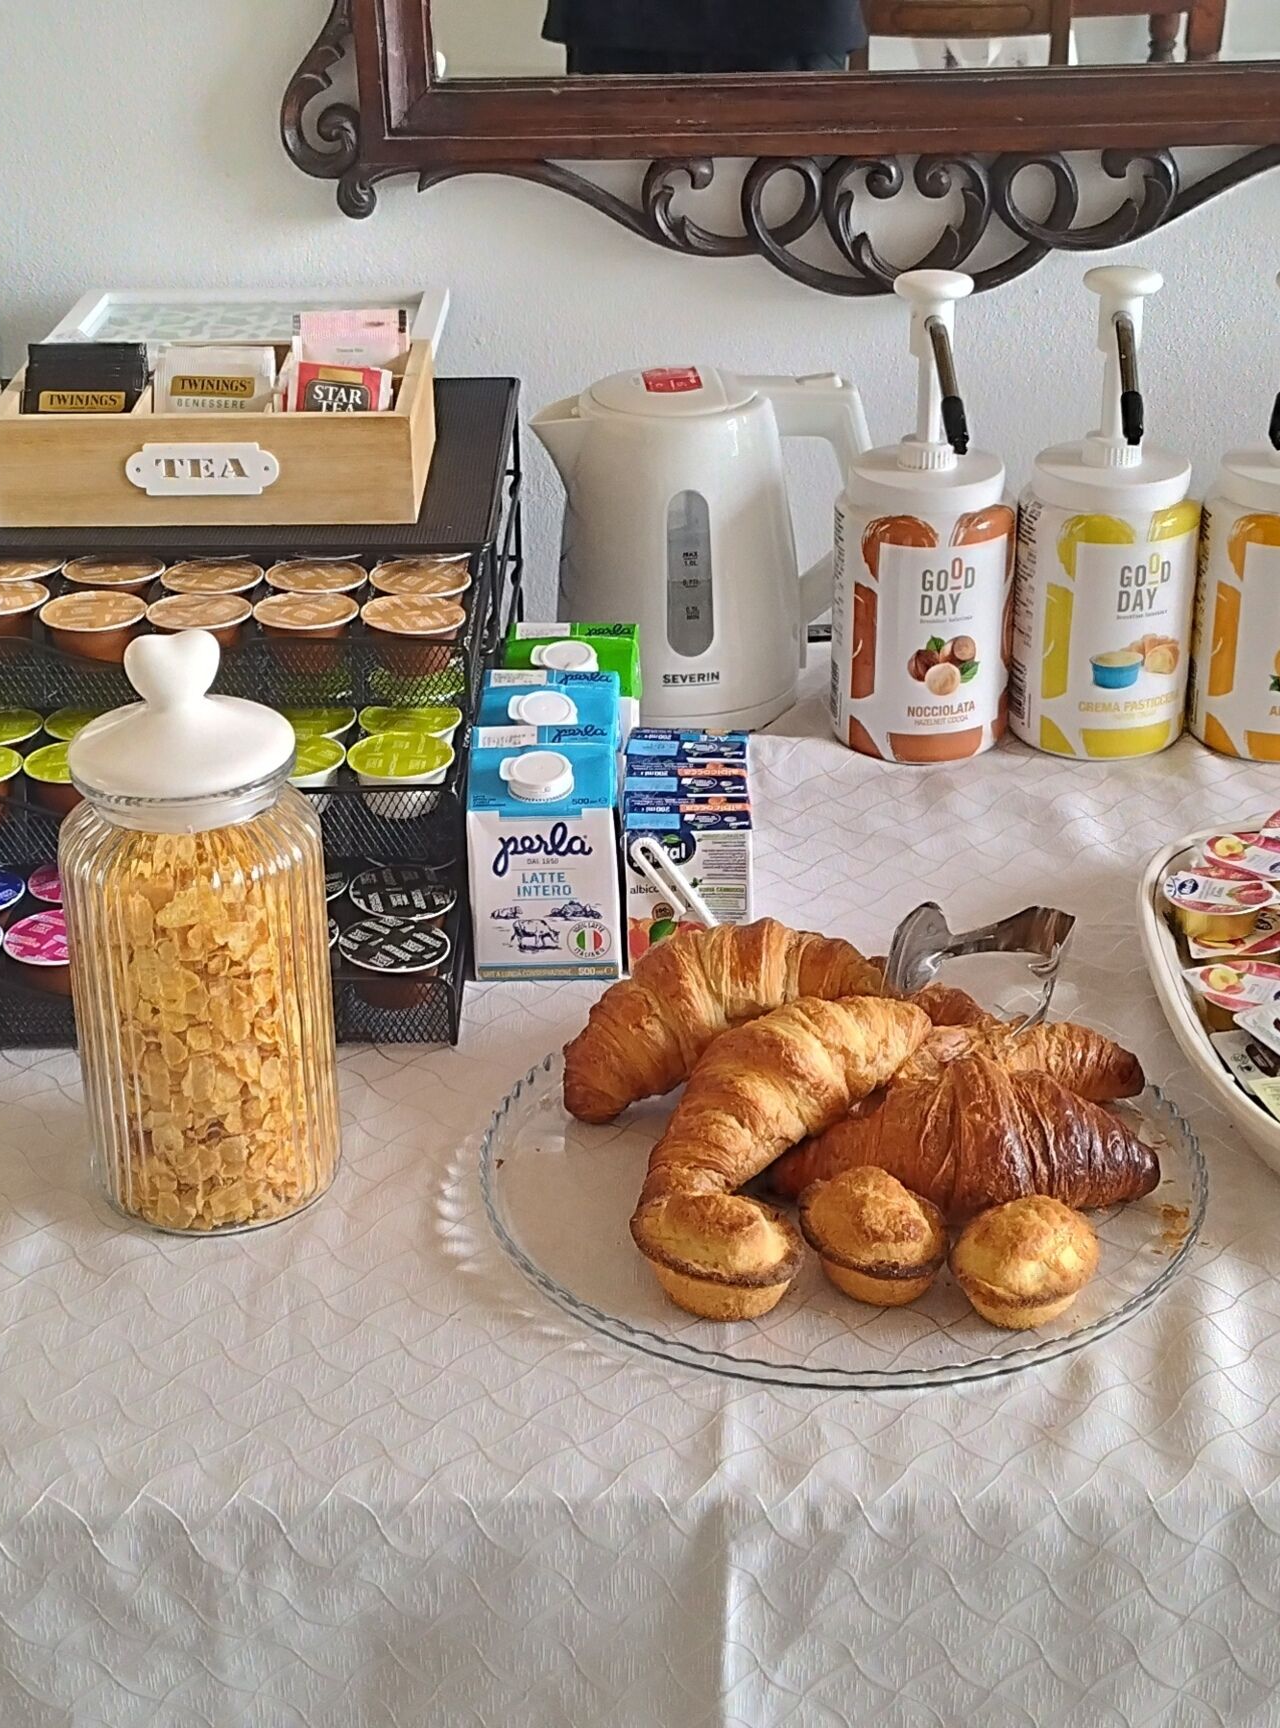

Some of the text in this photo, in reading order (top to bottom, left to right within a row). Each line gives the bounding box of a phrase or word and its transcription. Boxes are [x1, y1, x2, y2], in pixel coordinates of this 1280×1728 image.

[180, 378, 247, 393] TWININGS
[48, 393, 118, 406] TWININGS
[313, 385, 363, 405] STAR
[176, 398, 246, 410] BENESSERE
[317, 400, 356, 412] TEA
[154, 458, 252, 479] TEA
[921, 557, 976, 592] GOOD
[1119, 552, 1172, 588] GOOD
[919, 593, 962, 617] DAY
[1116, 587, 1158, 613] DAY
[585, 624, 634, 637] perla
[559, 672, 613, 685] perla
[663, 672, 720, 684] SEVERIN
[907, 700, 976, 718] NOCCIOLATA
[1078, 701, 1121, 713] CREMA
[552, 724, 608, 744] perla
[492, 822, 593, 878] perla
[521, 872, 566, 884] LATTE
[517, 884, 572, 897] INTERO
[578, 967, 596, 976] 500
